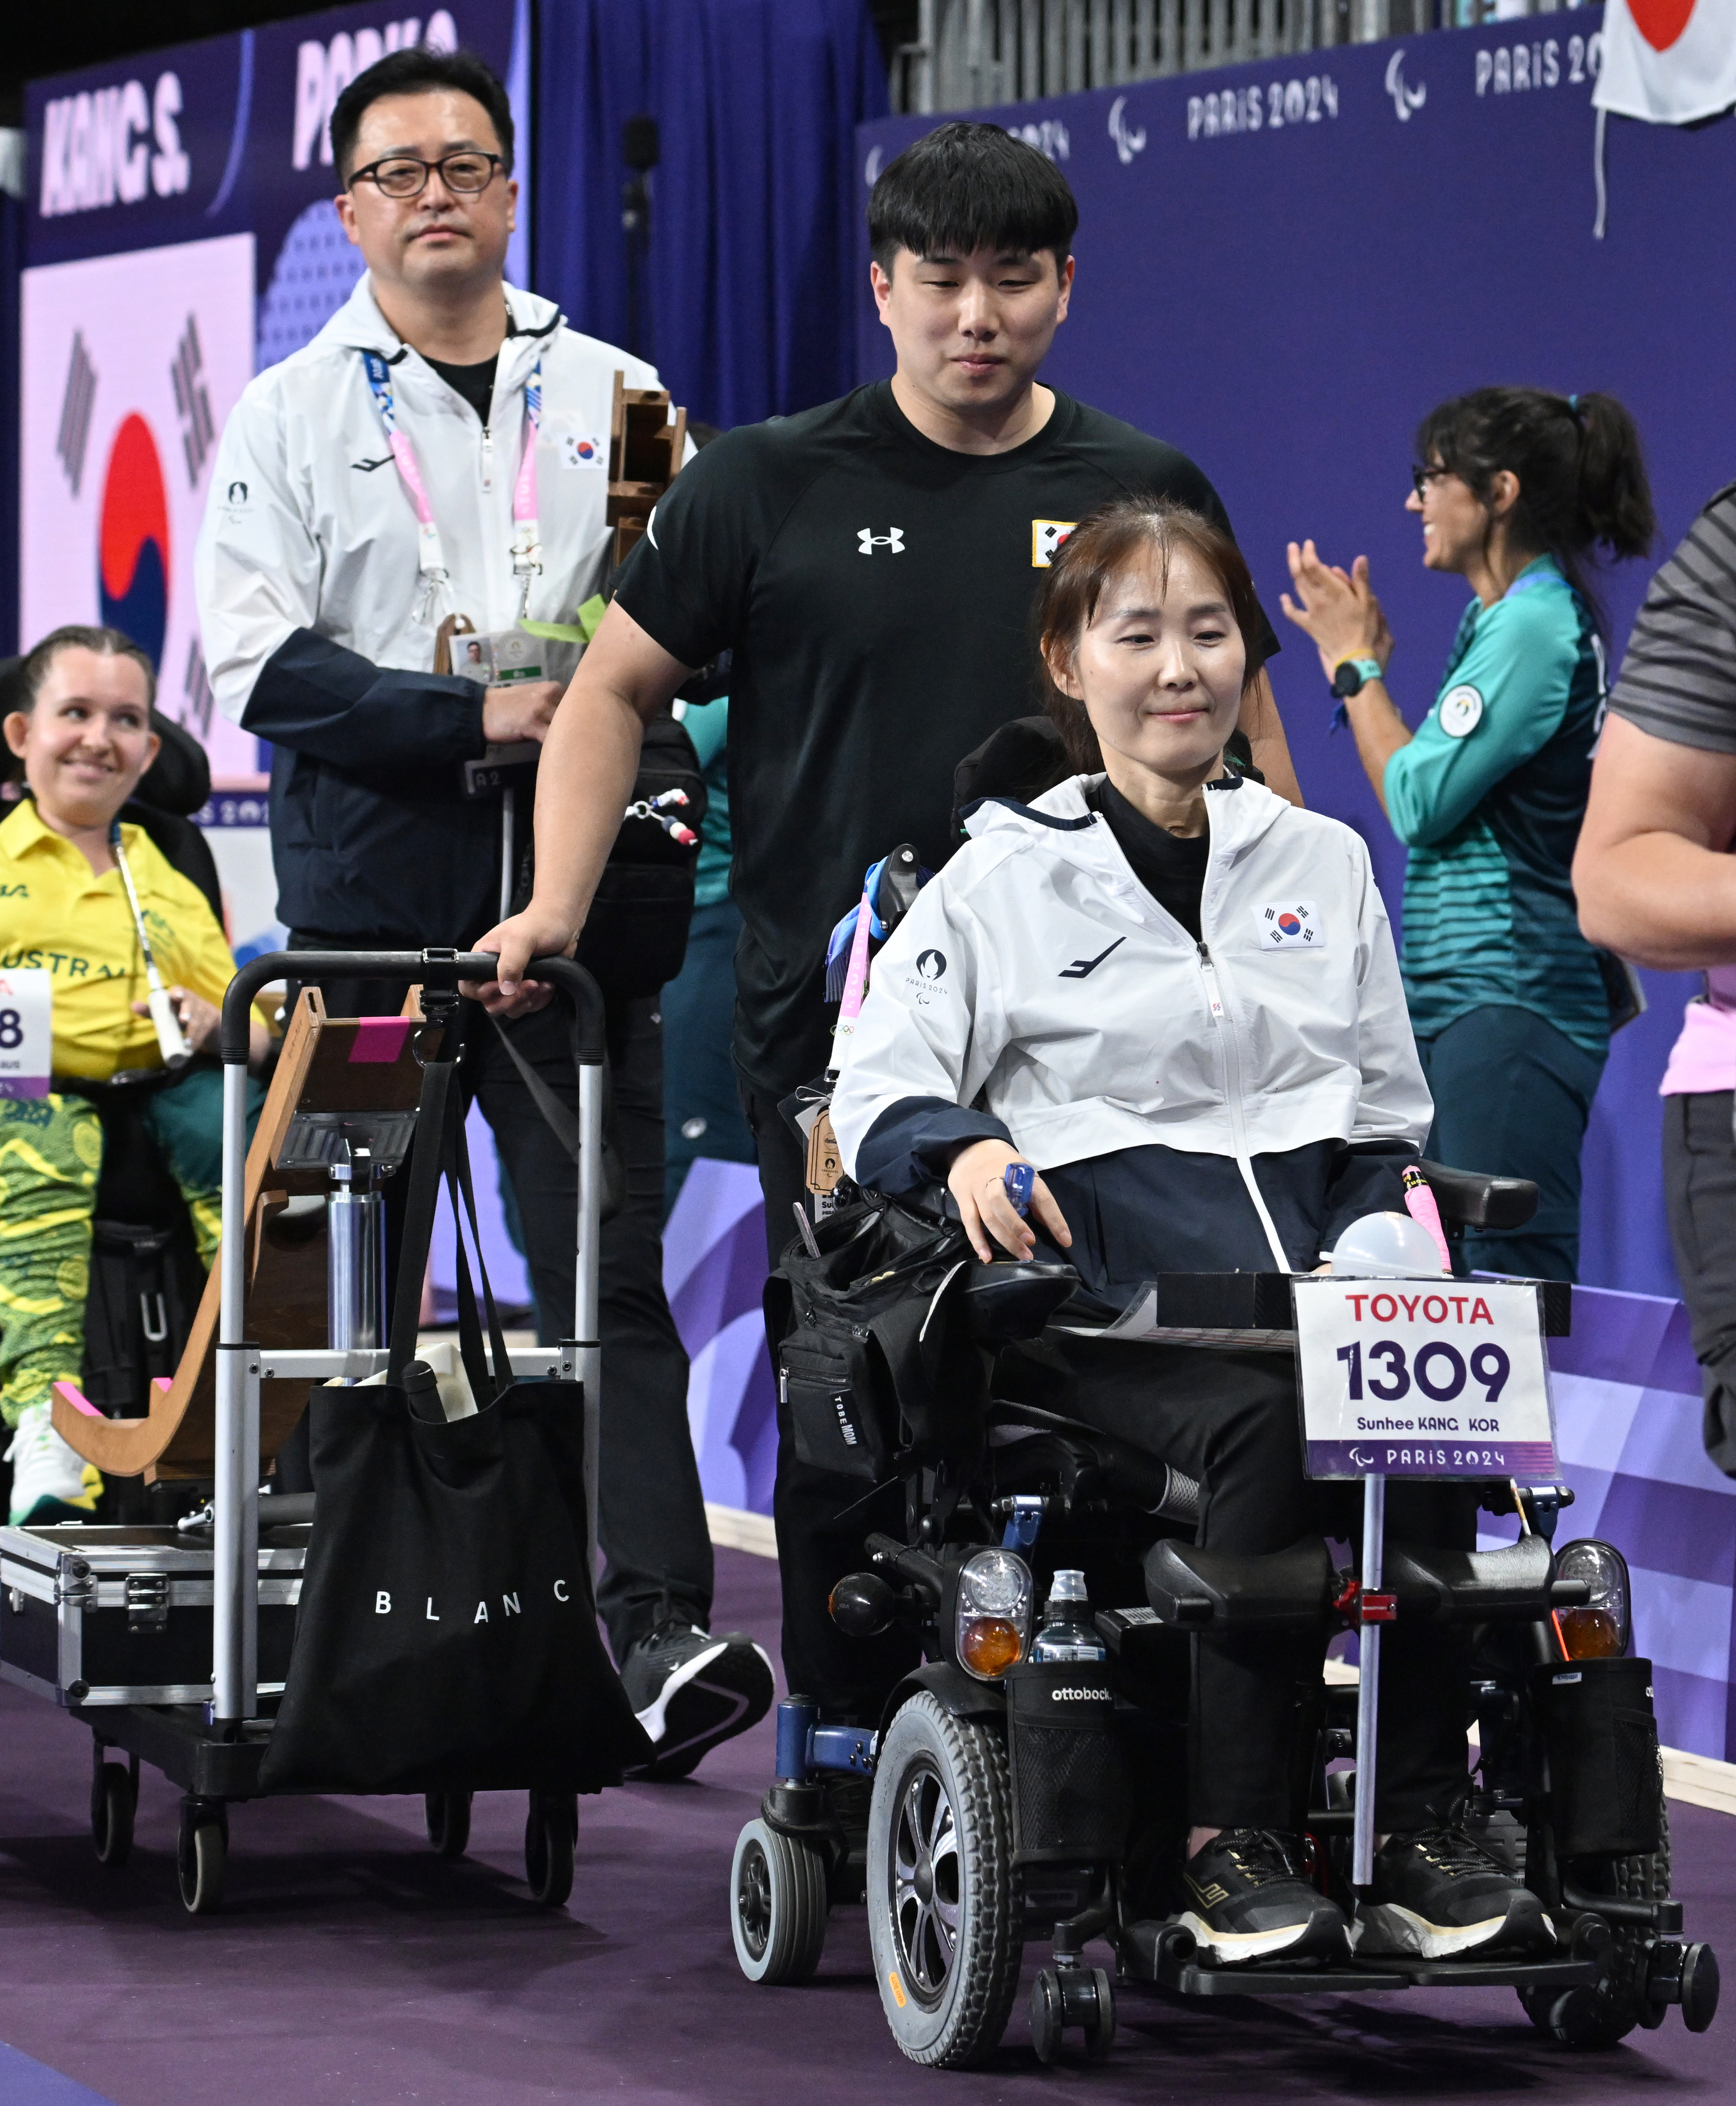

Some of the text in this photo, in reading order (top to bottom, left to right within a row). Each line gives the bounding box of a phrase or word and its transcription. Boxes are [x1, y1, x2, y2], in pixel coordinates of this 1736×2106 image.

[1267, 74, 1339, 130] 2024
[855, 903, 870, 955] PARIS
[846, 962, 860, 1008] 2024
[929, 985, 947, 995] 2024
[1345, 1293, 1494, 1325] TOYOTA
[1336, 1339, 1510, 1403] 1309
[1357, 1417, 1500, 1432] Sunhee KANG KOR
[1453, 1450, 1505, 1466] 2024
